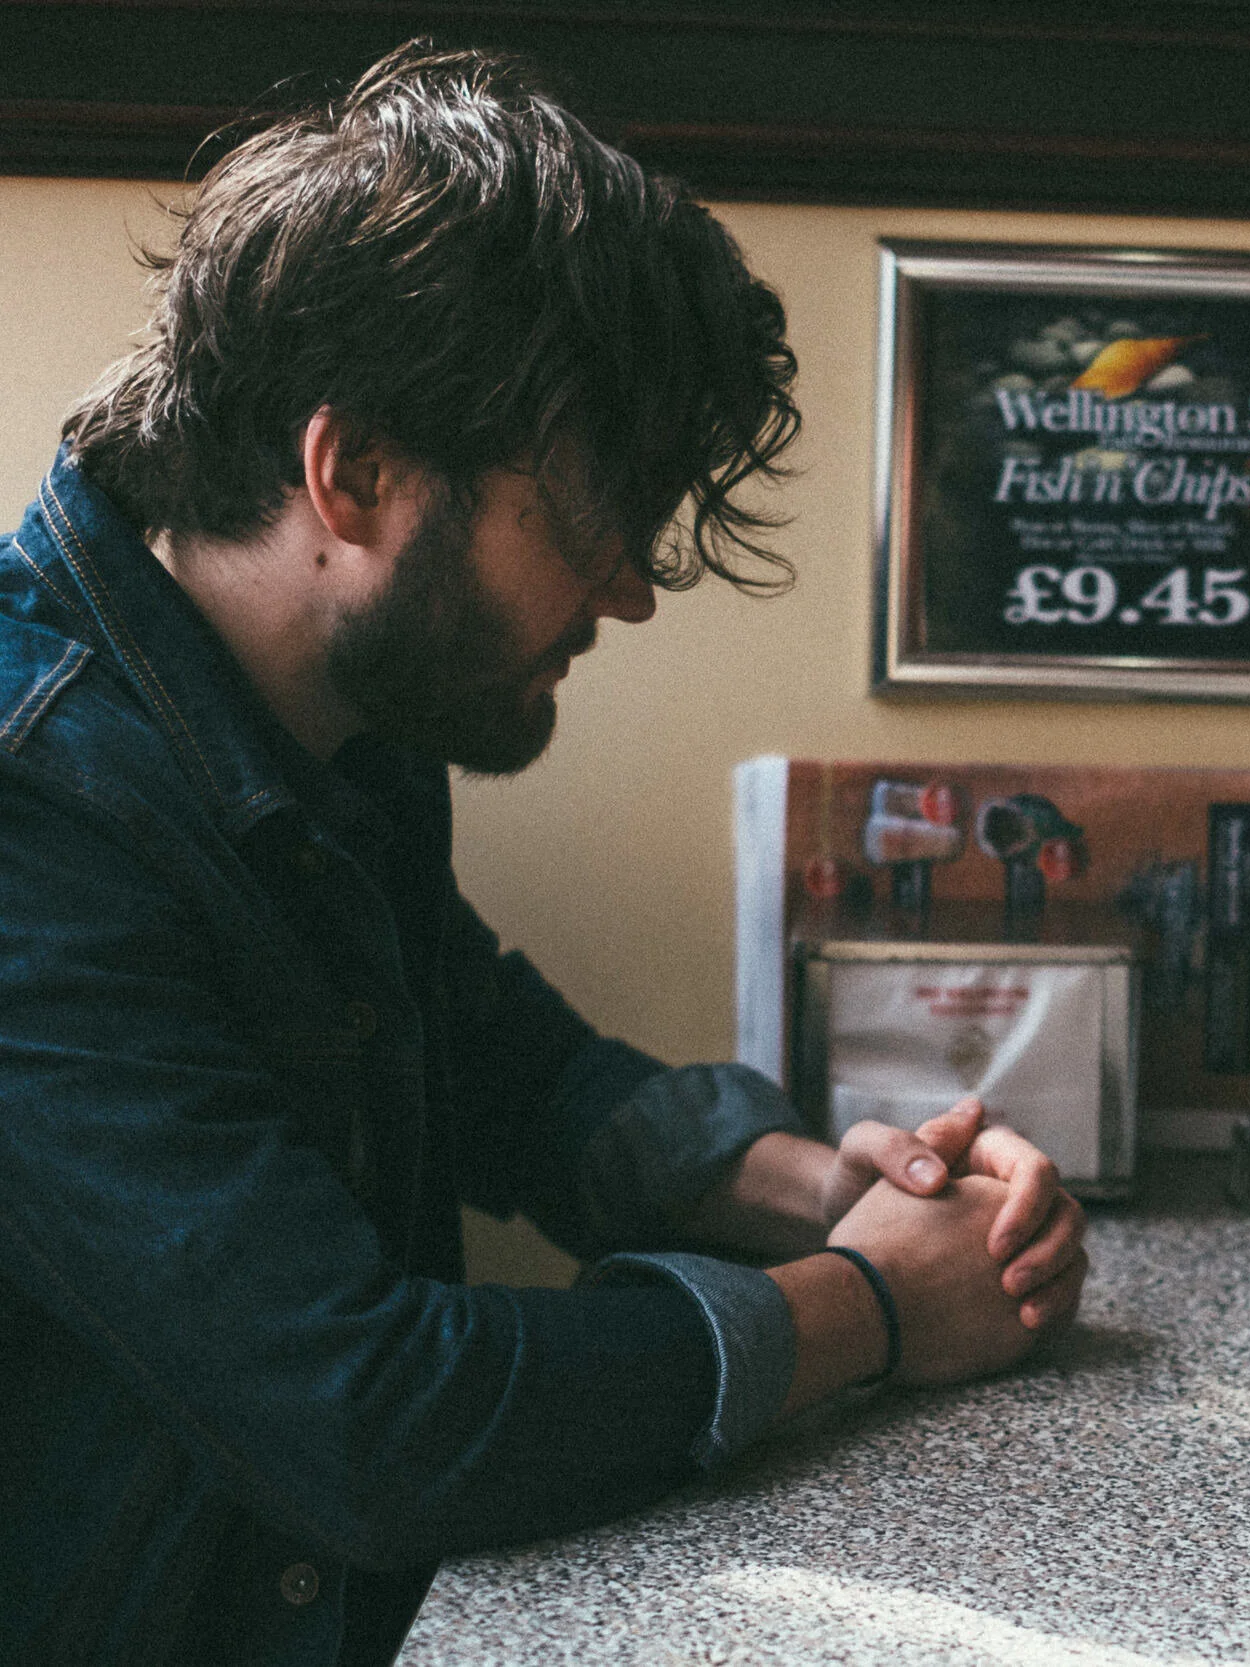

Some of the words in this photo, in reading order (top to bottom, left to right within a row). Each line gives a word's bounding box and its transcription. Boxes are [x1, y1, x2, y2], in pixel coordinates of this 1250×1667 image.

[996, 389, 1237, 448] Wellington
[996, 456, 1082, 503] Fish
[1003, 564, 1250, 626] £9.45
